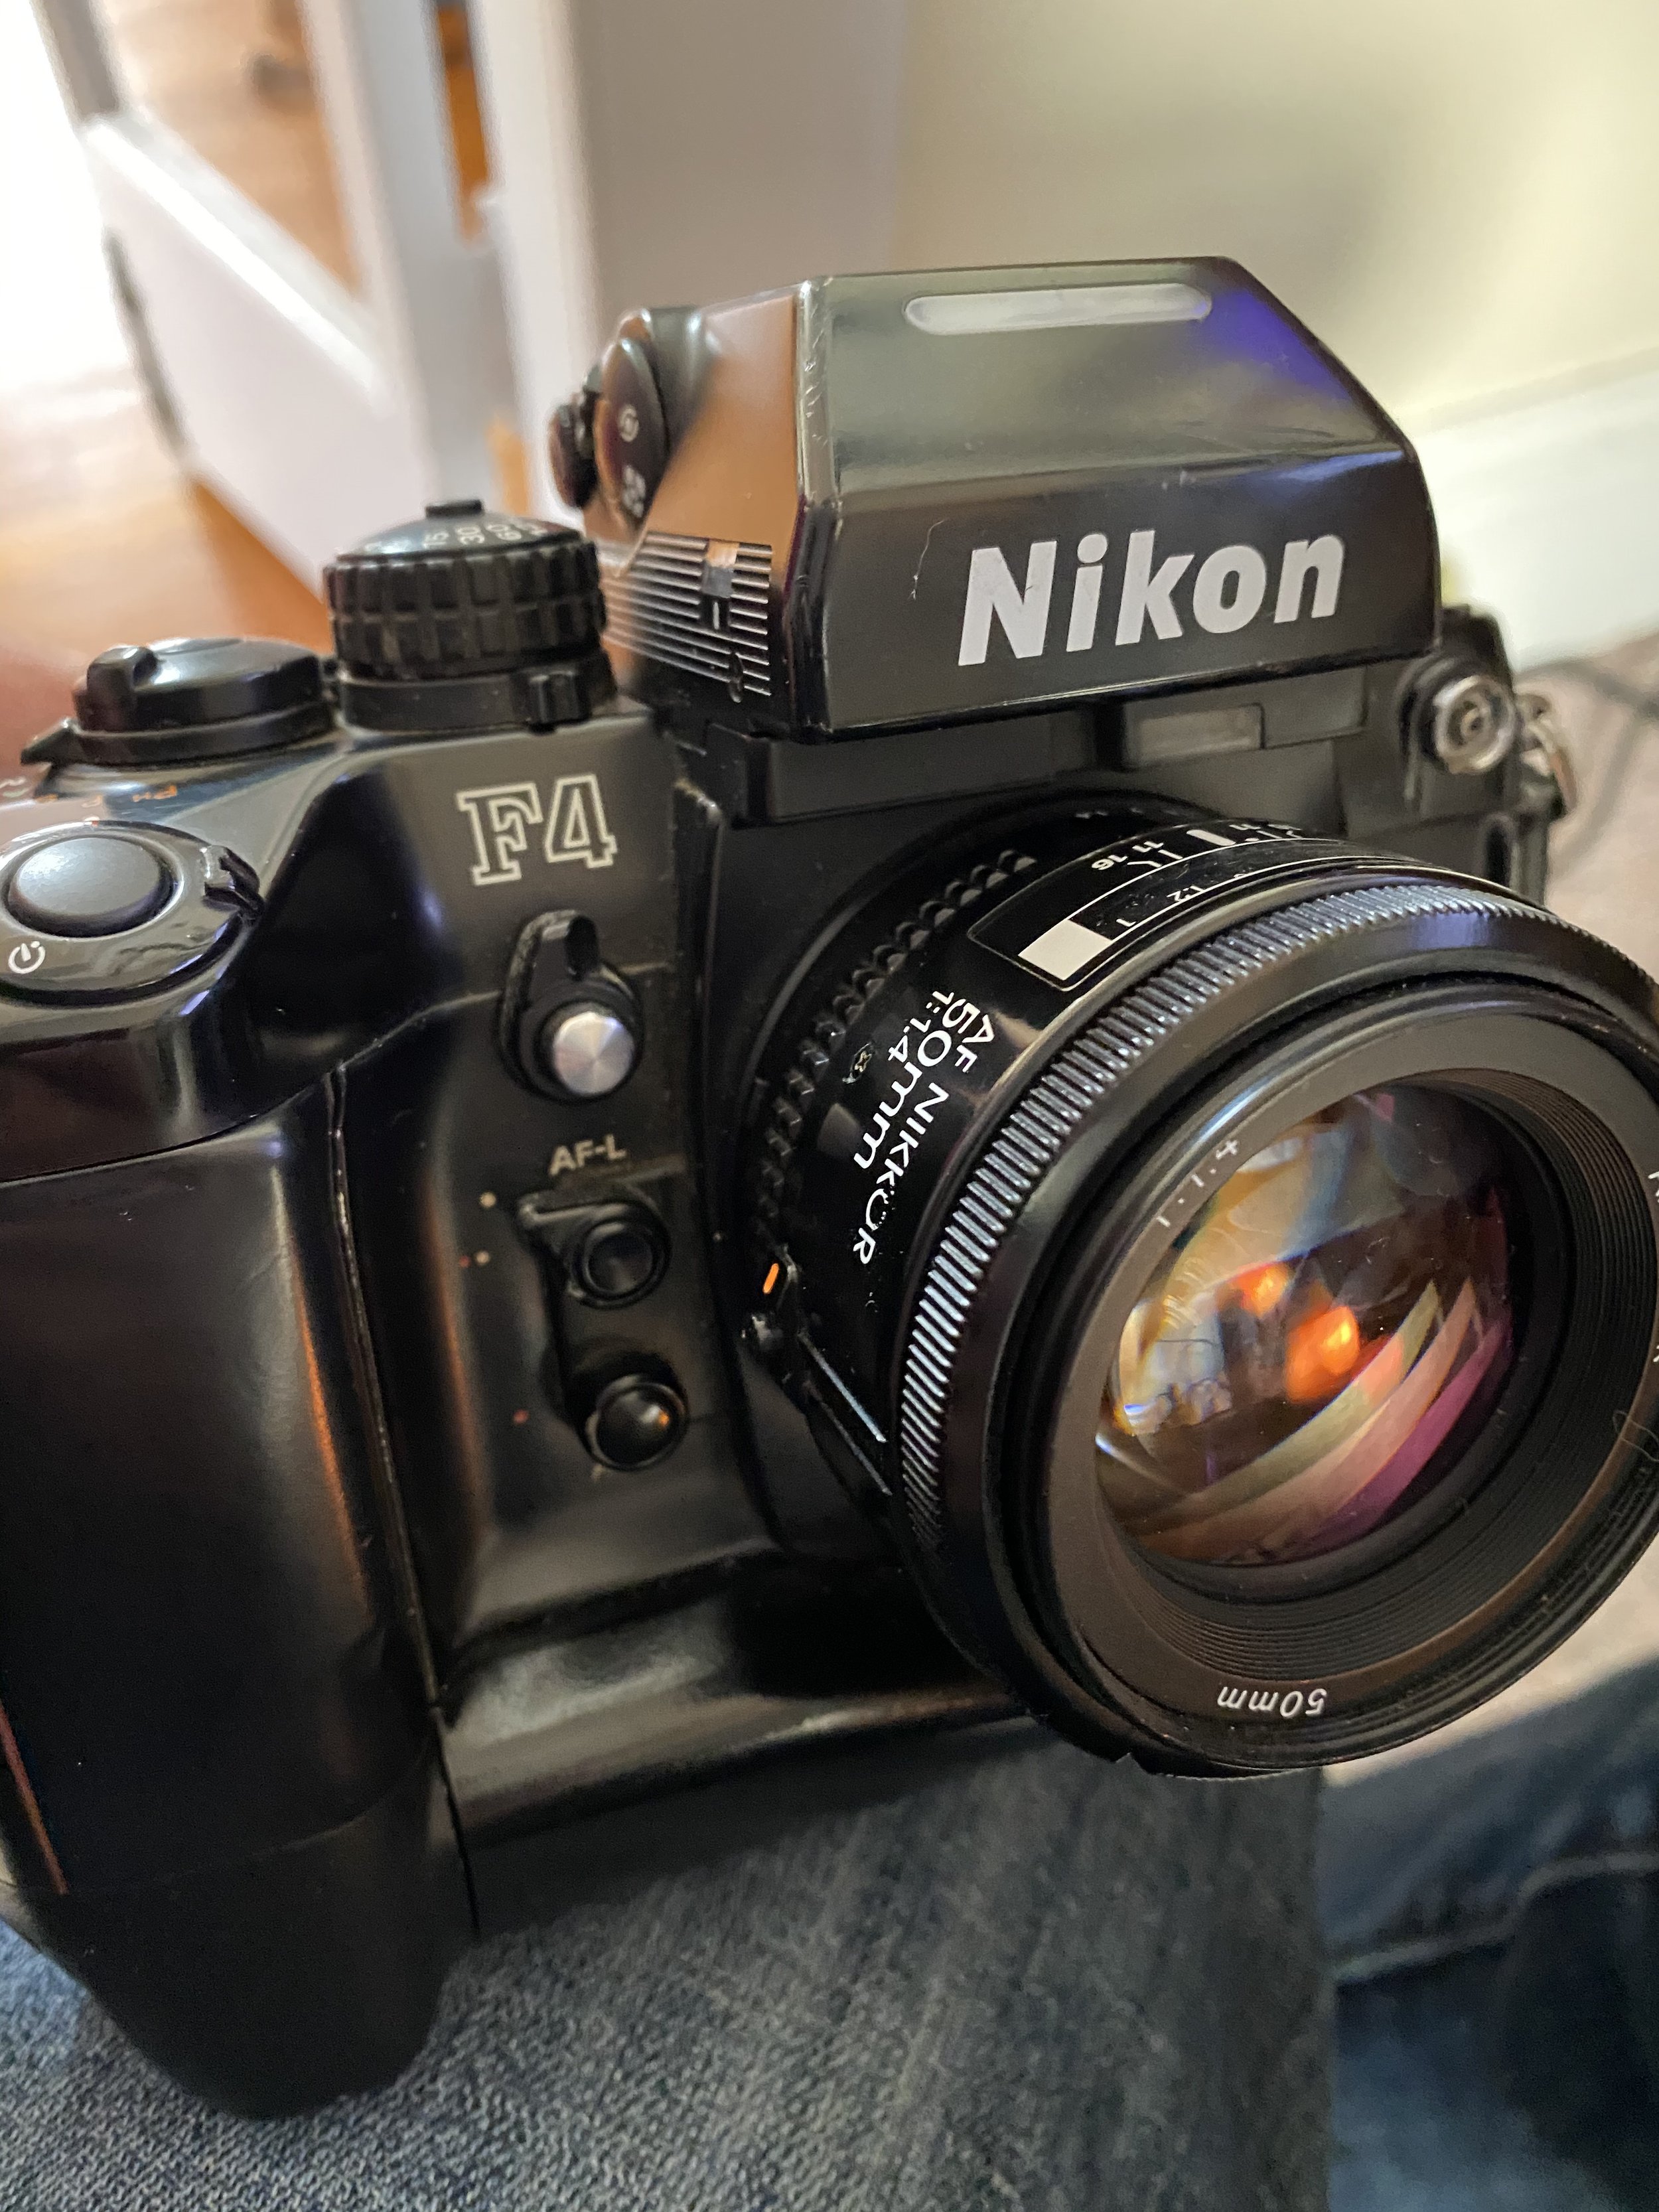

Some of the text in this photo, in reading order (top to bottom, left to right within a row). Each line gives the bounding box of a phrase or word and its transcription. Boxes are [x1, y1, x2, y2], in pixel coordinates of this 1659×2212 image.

[455, 524, 486, 546] 30
[958, 529, 1345, 666] Nikon
[455, 773, 618, 886] F4
[1091, 854, 1128, 871] 16
[887, 990, 955, 1062] 1:1.4
[853, 997, 981, 1169] 50mm
[548, 1134, 627, 1177] AF-L
[851, 1013, 995, 1265] AF NIKKOR
[1216, 1686, 1327, 1719] 50mm
